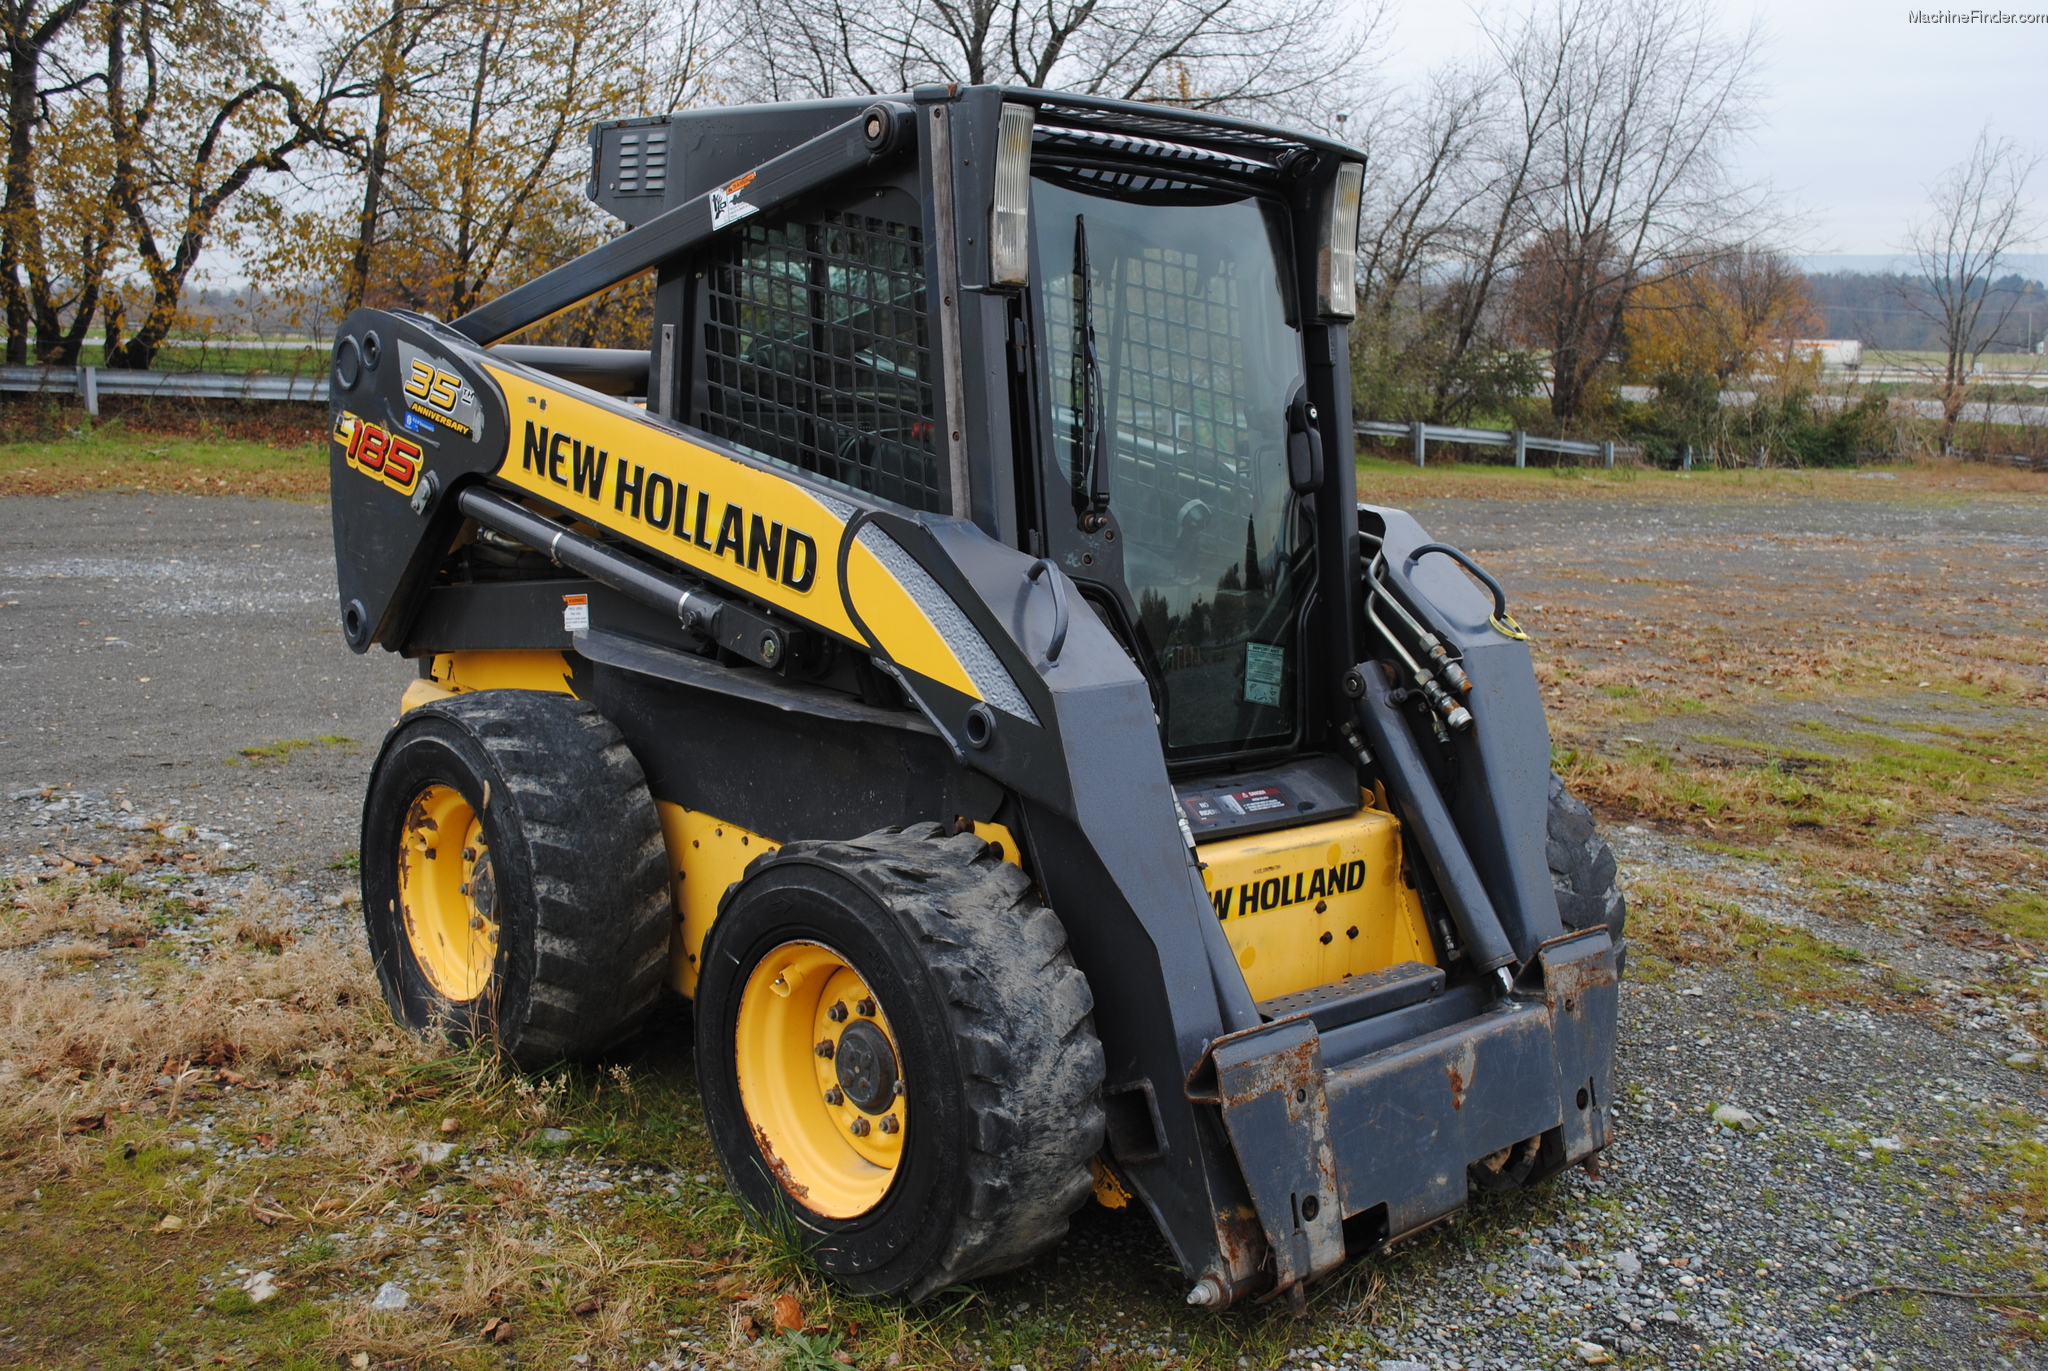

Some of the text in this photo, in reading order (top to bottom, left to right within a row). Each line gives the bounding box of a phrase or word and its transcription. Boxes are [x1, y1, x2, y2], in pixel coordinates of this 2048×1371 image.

[411, 402, 470, 436] ANNIVERSARY
[522, 418, 818, 595] NEW HOLLAND
[1198, 801, 1210, 809] NO
[1239, 859, 1366, 917] HOLLAND
